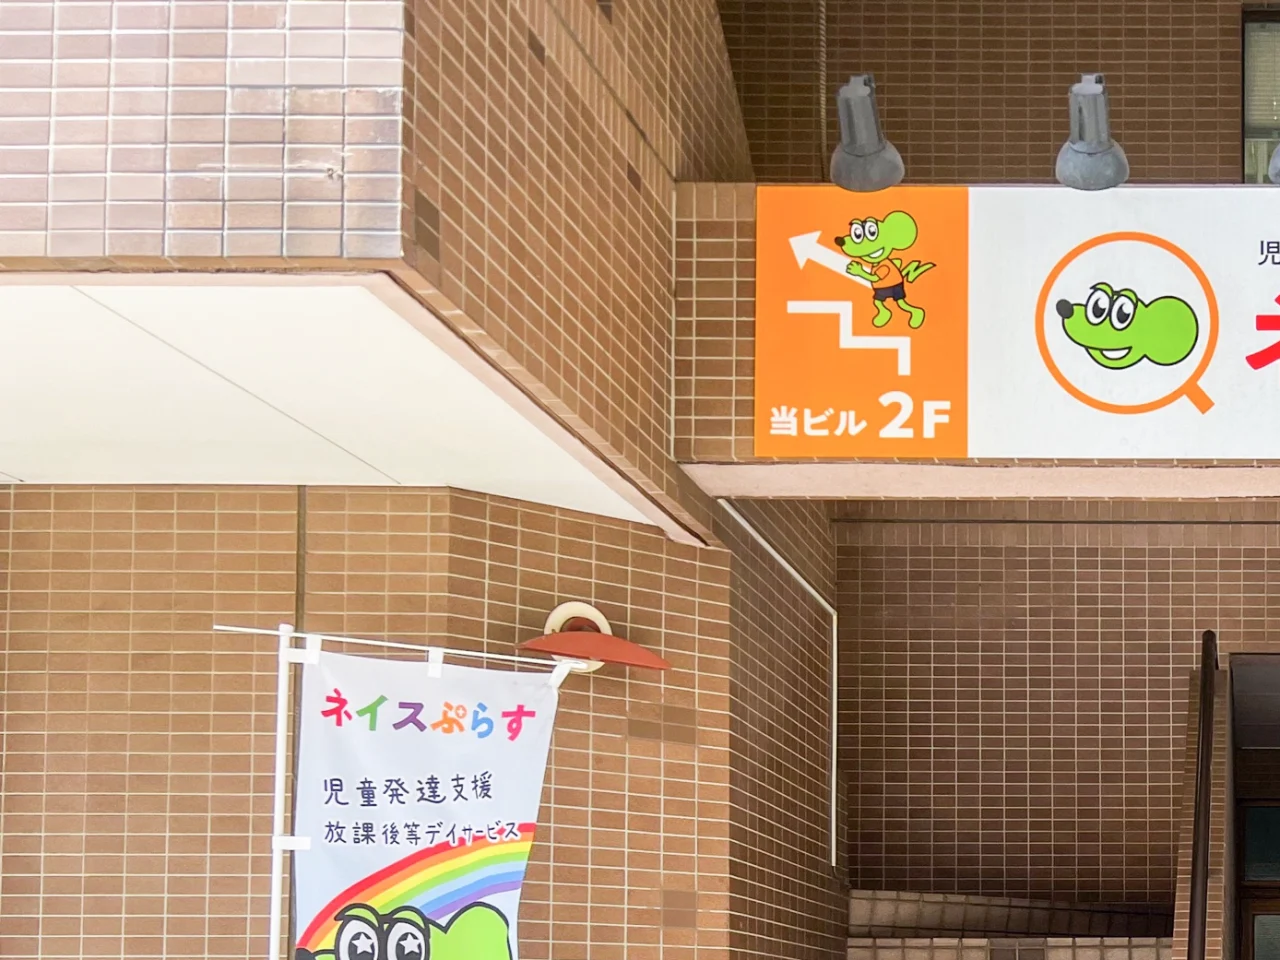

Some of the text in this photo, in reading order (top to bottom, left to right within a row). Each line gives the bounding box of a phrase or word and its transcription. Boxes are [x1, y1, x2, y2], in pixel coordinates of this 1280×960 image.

[769, 391, 952, 439] 当ビル 2F
[320, 687, 537, 741] ネイスぷらす
[323, 770, 494, 807] 児童発達支援
[323, 820, 522, 847] 放課後等デイサービス
